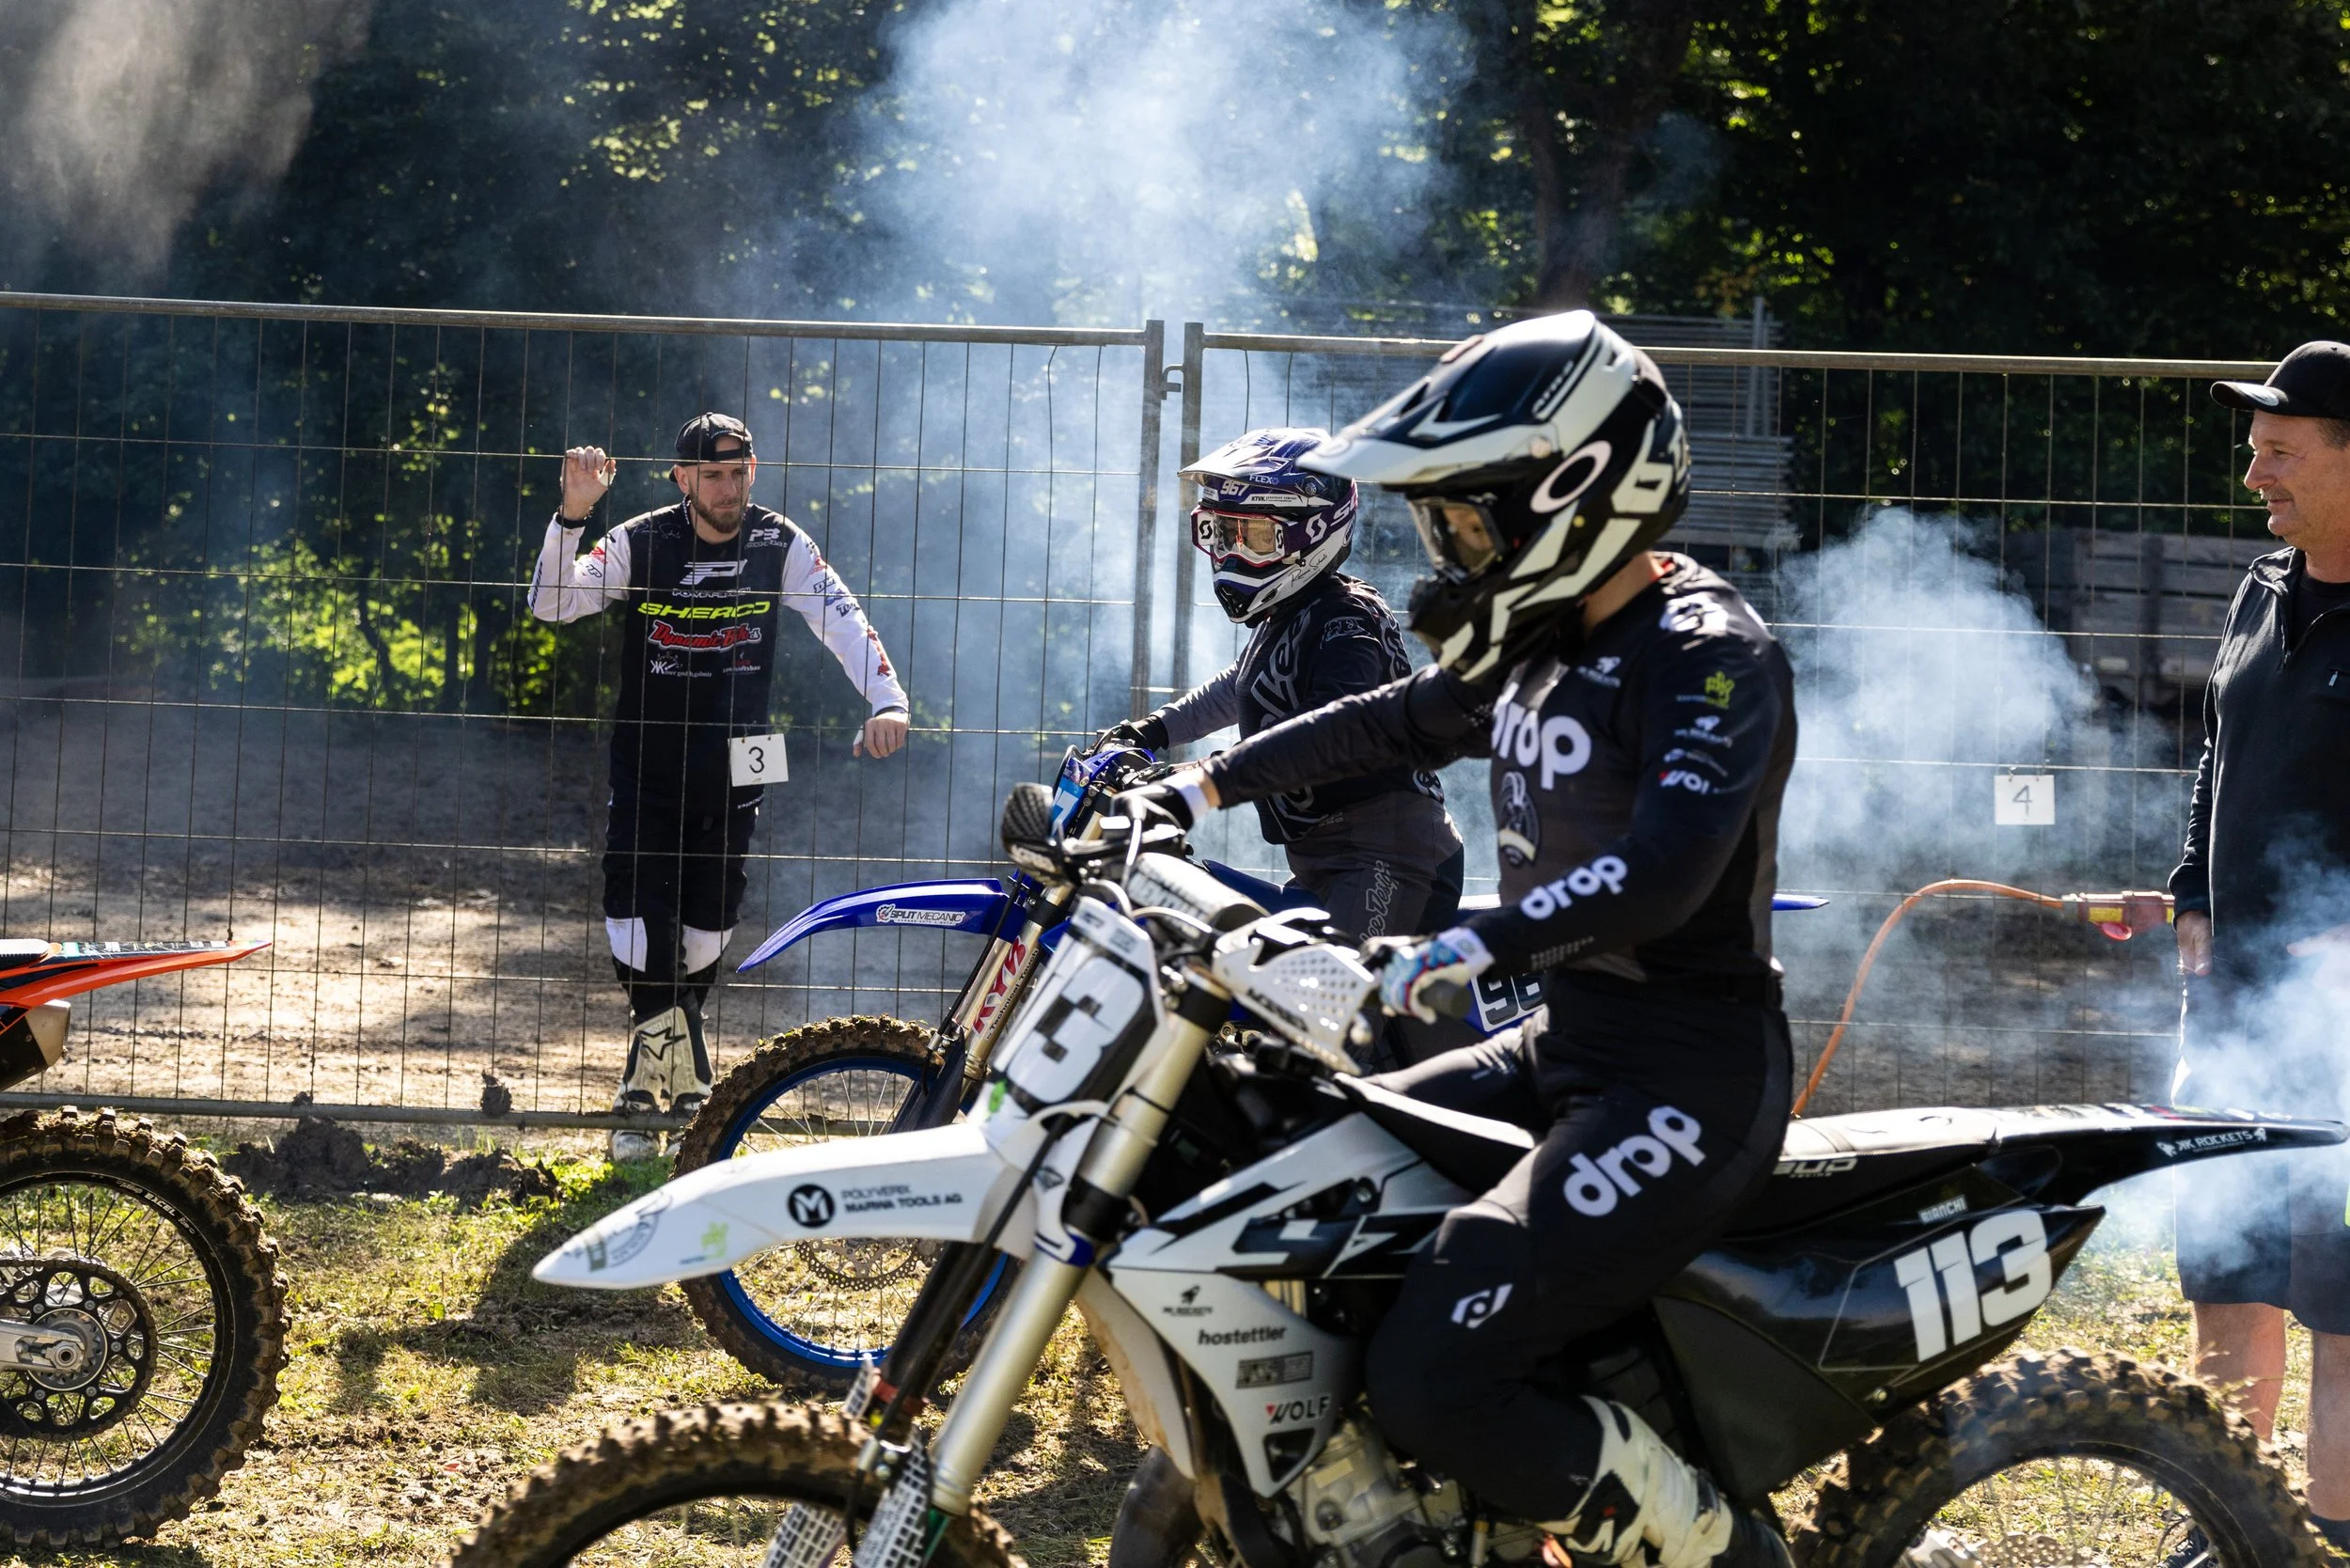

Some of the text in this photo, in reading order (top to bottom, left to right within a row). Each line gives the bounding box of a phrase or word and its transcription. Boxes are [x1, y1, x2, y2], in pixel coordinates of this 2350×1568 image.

[1220, 478, 1250, 496] 967
[637, 601, 771, 619] SHERCO
[748, 745, 765, 774] 3
[2013, 785, 2033, 817] 4
[1520, 855, 1628, 919] drop
[890, 910, 917, 919] SPLIT
[972, 936, 1026, 1034] KYB
[989, 948, 1039, 1030] Technical Touch
[2196, 1131, 2253, 1149] ROCKETS
[1563, 1105, 1706, 1216] drop
[144, 1193, 177, 1216] EXCEL
[897, 1195, 941, 1207] TOOLS
[1919, 1196, 1967, 1222] BIANCHI
[1893, 1209, 2053, 1363] 113
[1198, 1326, 1287, 1345] hostettler
[1269, 1396, 1330, 1424] WOLF
